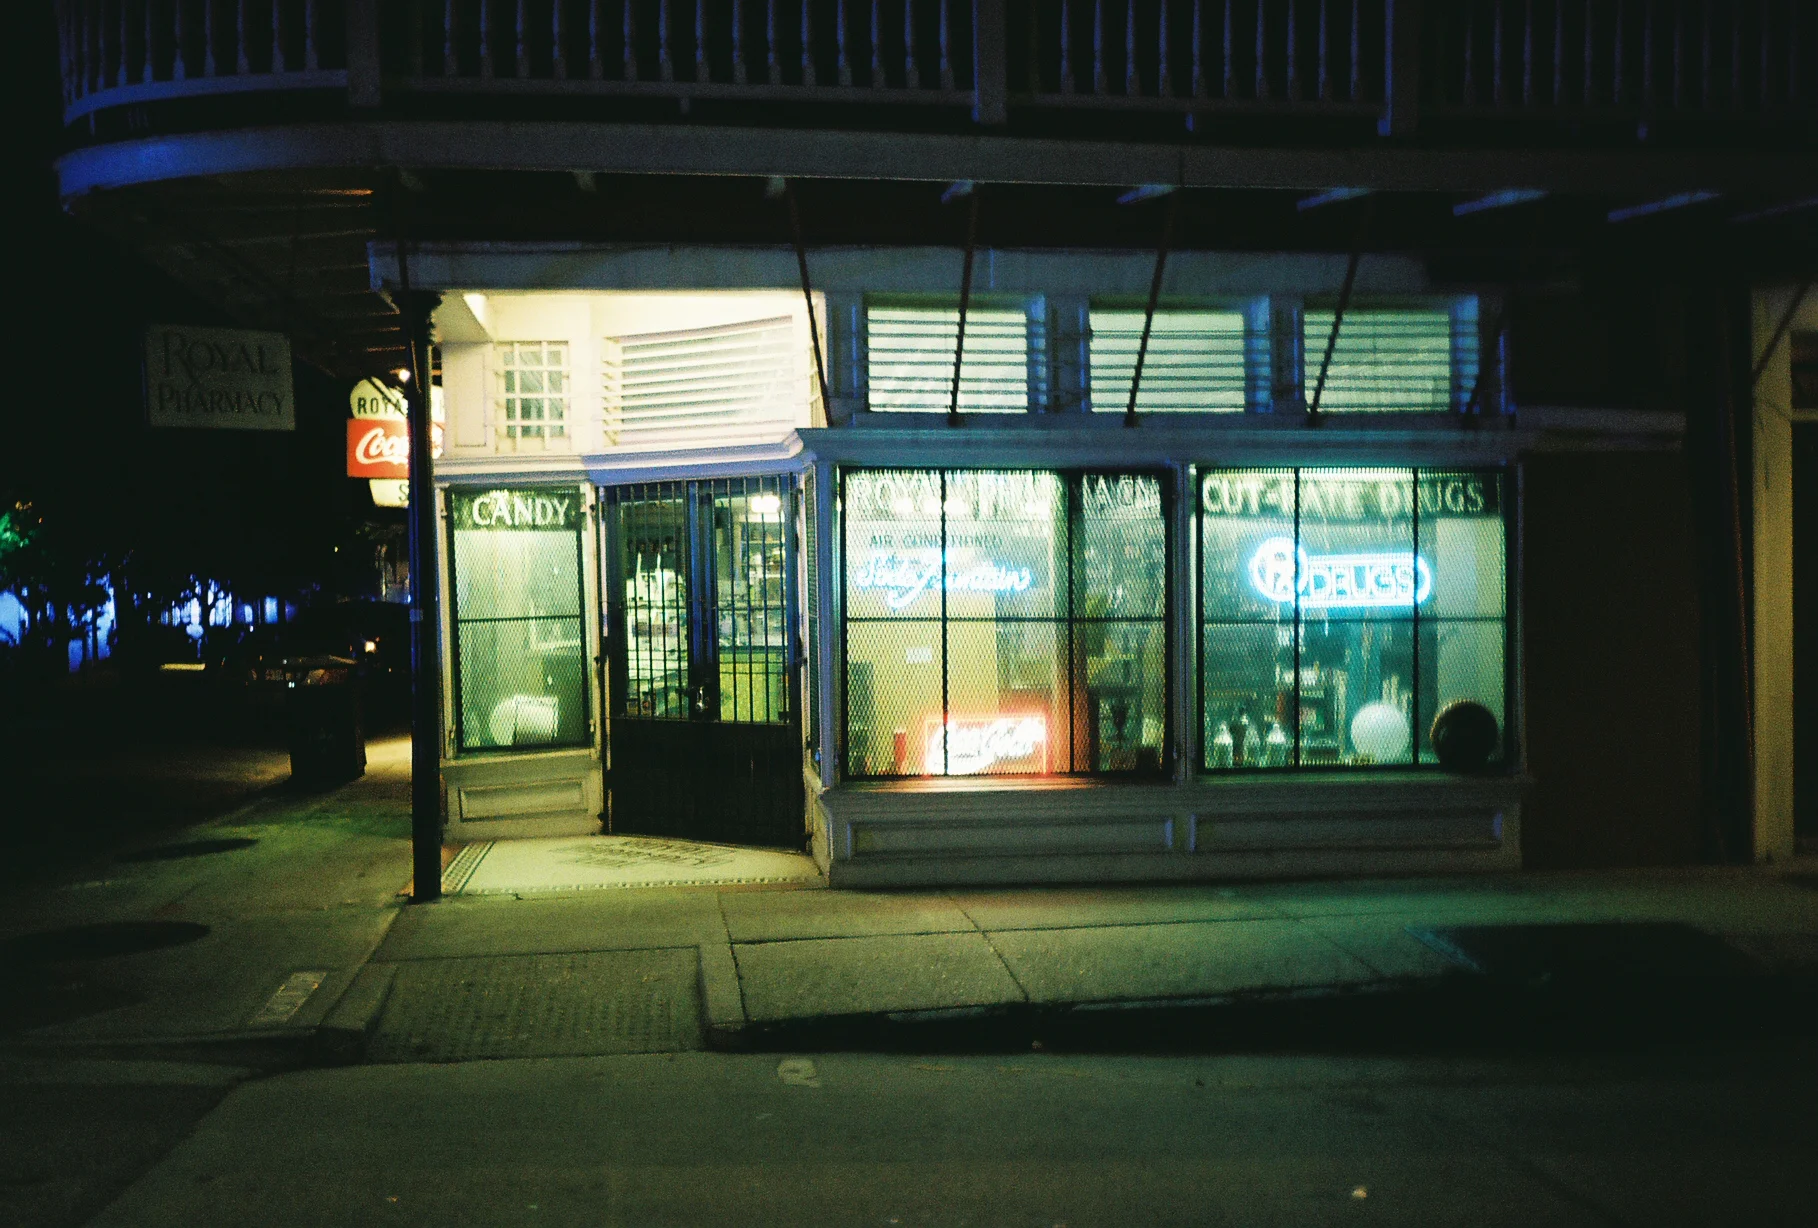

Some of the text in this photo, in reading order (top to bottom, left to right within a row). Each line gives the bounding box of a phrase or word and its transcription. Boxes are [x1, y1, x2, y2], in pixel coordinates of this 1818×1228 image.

[162, 331, 282, 381] ROYAL
[157, 381, 287, 416] PHARMACY
[472, 490, 570, 526] CANDY
[869, 532, 1004, 549] AIR CONDTIONED
[1309, 564, 1414, 600] DRUGS
